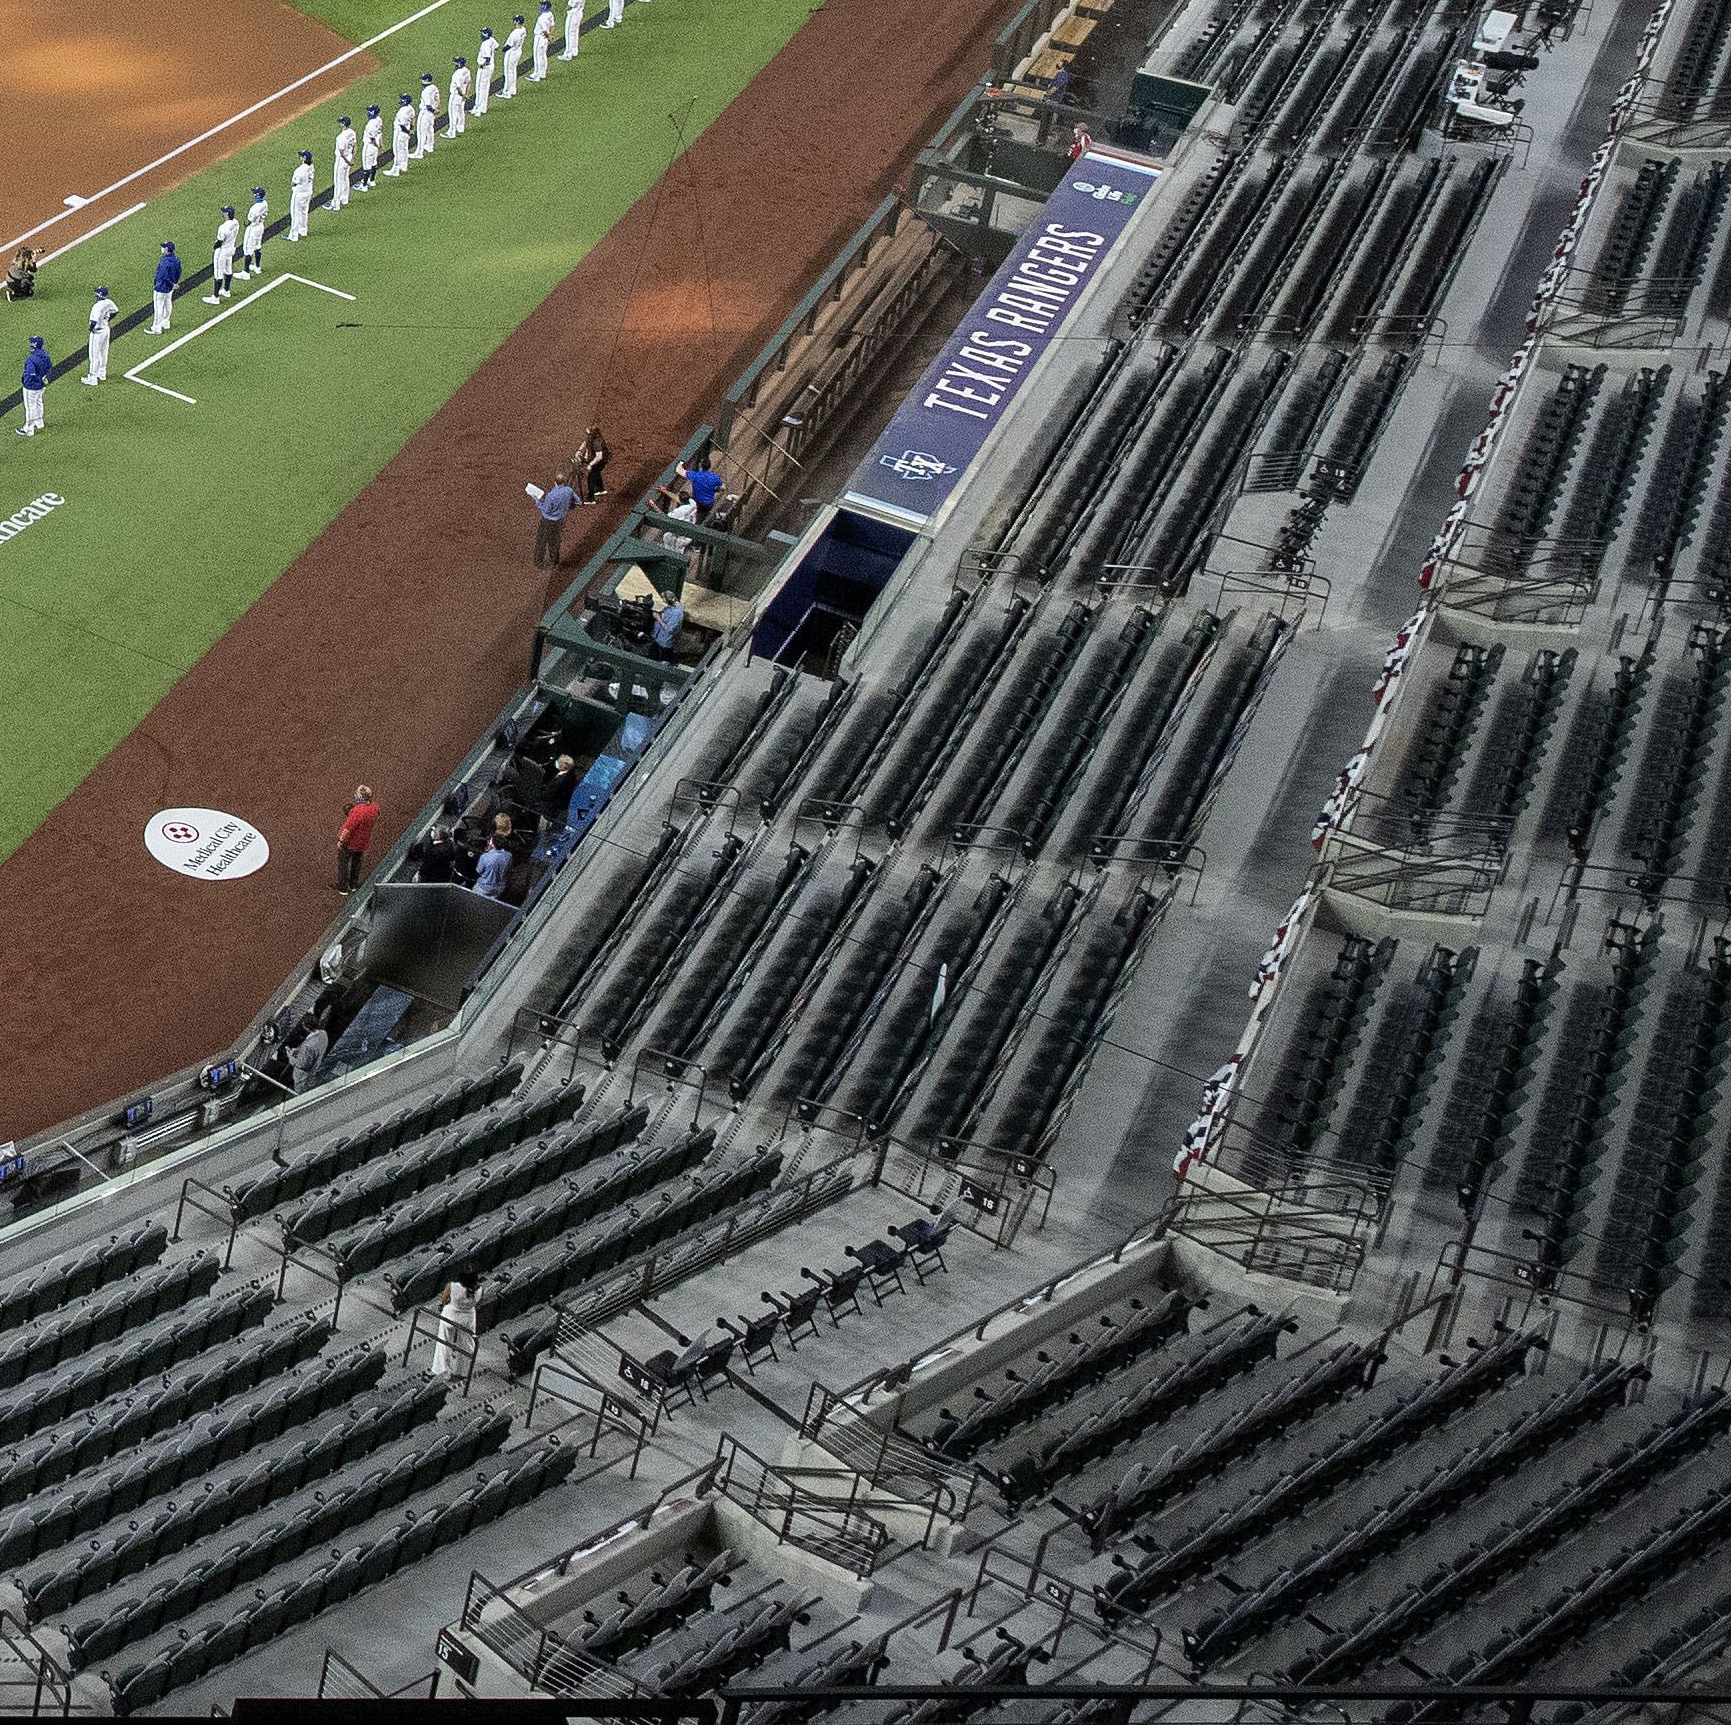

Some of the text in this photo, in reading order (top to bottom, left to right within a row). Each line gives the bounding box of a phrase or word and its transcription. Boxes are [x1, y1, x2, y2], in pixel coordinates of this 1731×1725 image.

[924, 223, 1105, 420] TEXAS RANGERS
[183, 819, 242, 871] Medical City
[204, 829, 258, 877] Healthcare
